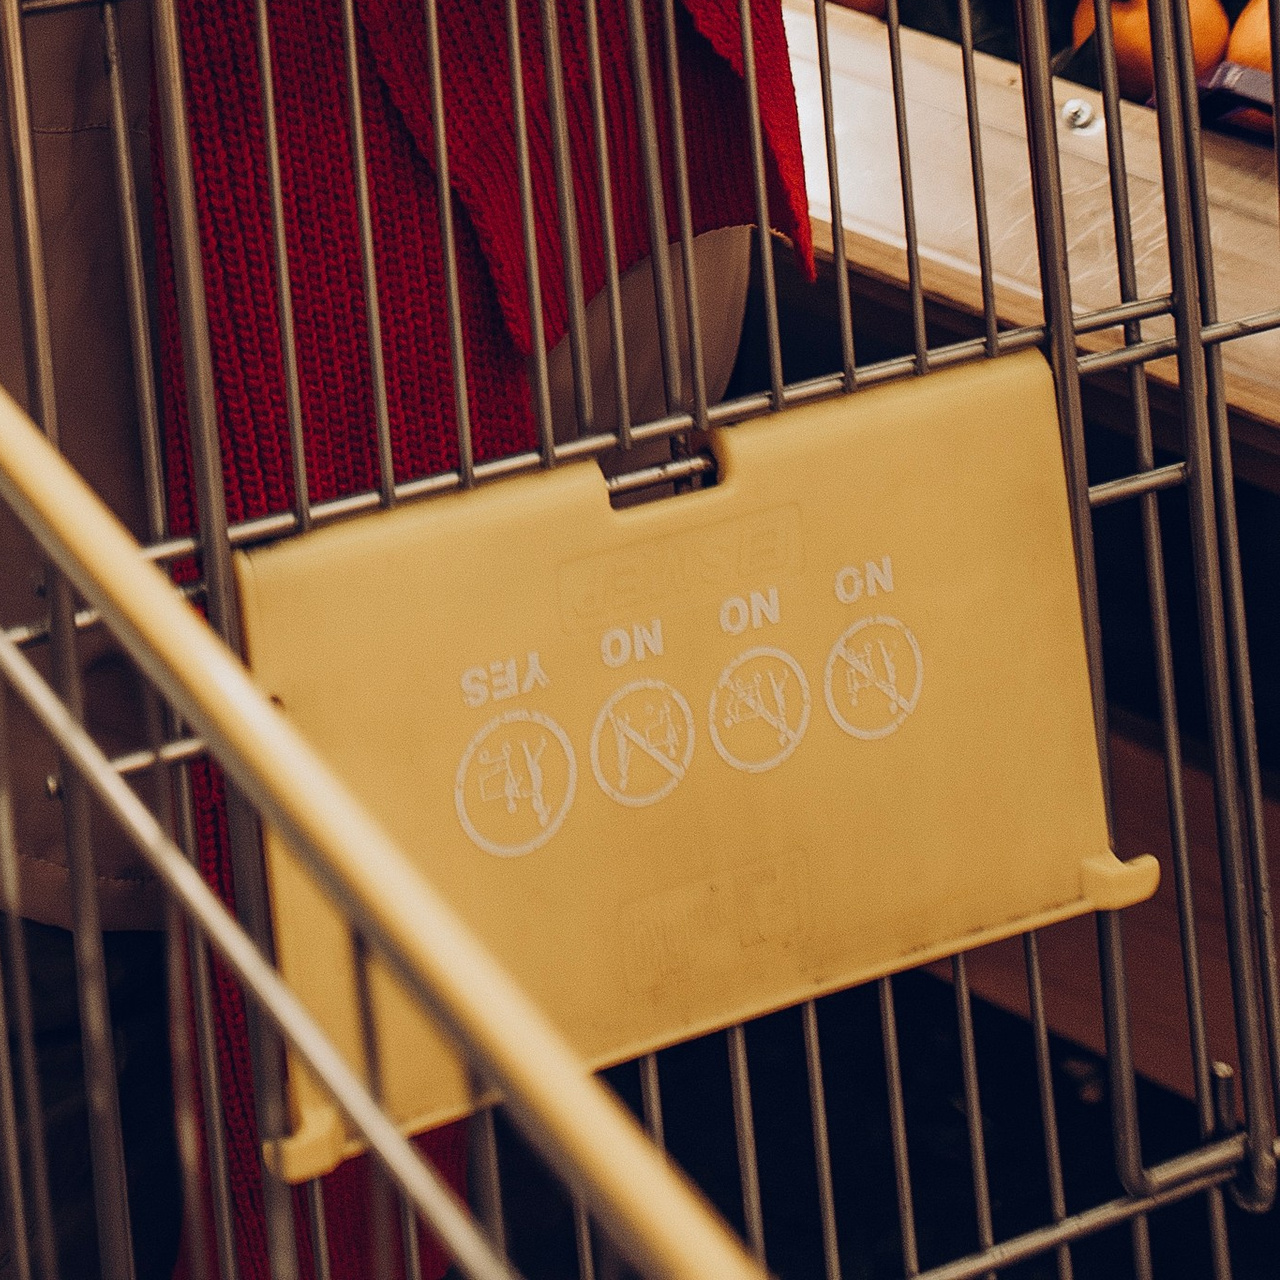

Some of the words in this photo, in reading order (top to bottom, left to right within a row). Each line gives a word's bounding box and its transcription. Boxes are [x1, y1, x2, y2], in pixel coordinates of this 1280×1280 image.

[834, 556, 894, 603] NO
[719, 586, 780, 634] NO
[600, 618, 664, 668] NO
[460, 651, 550, 707] YES
